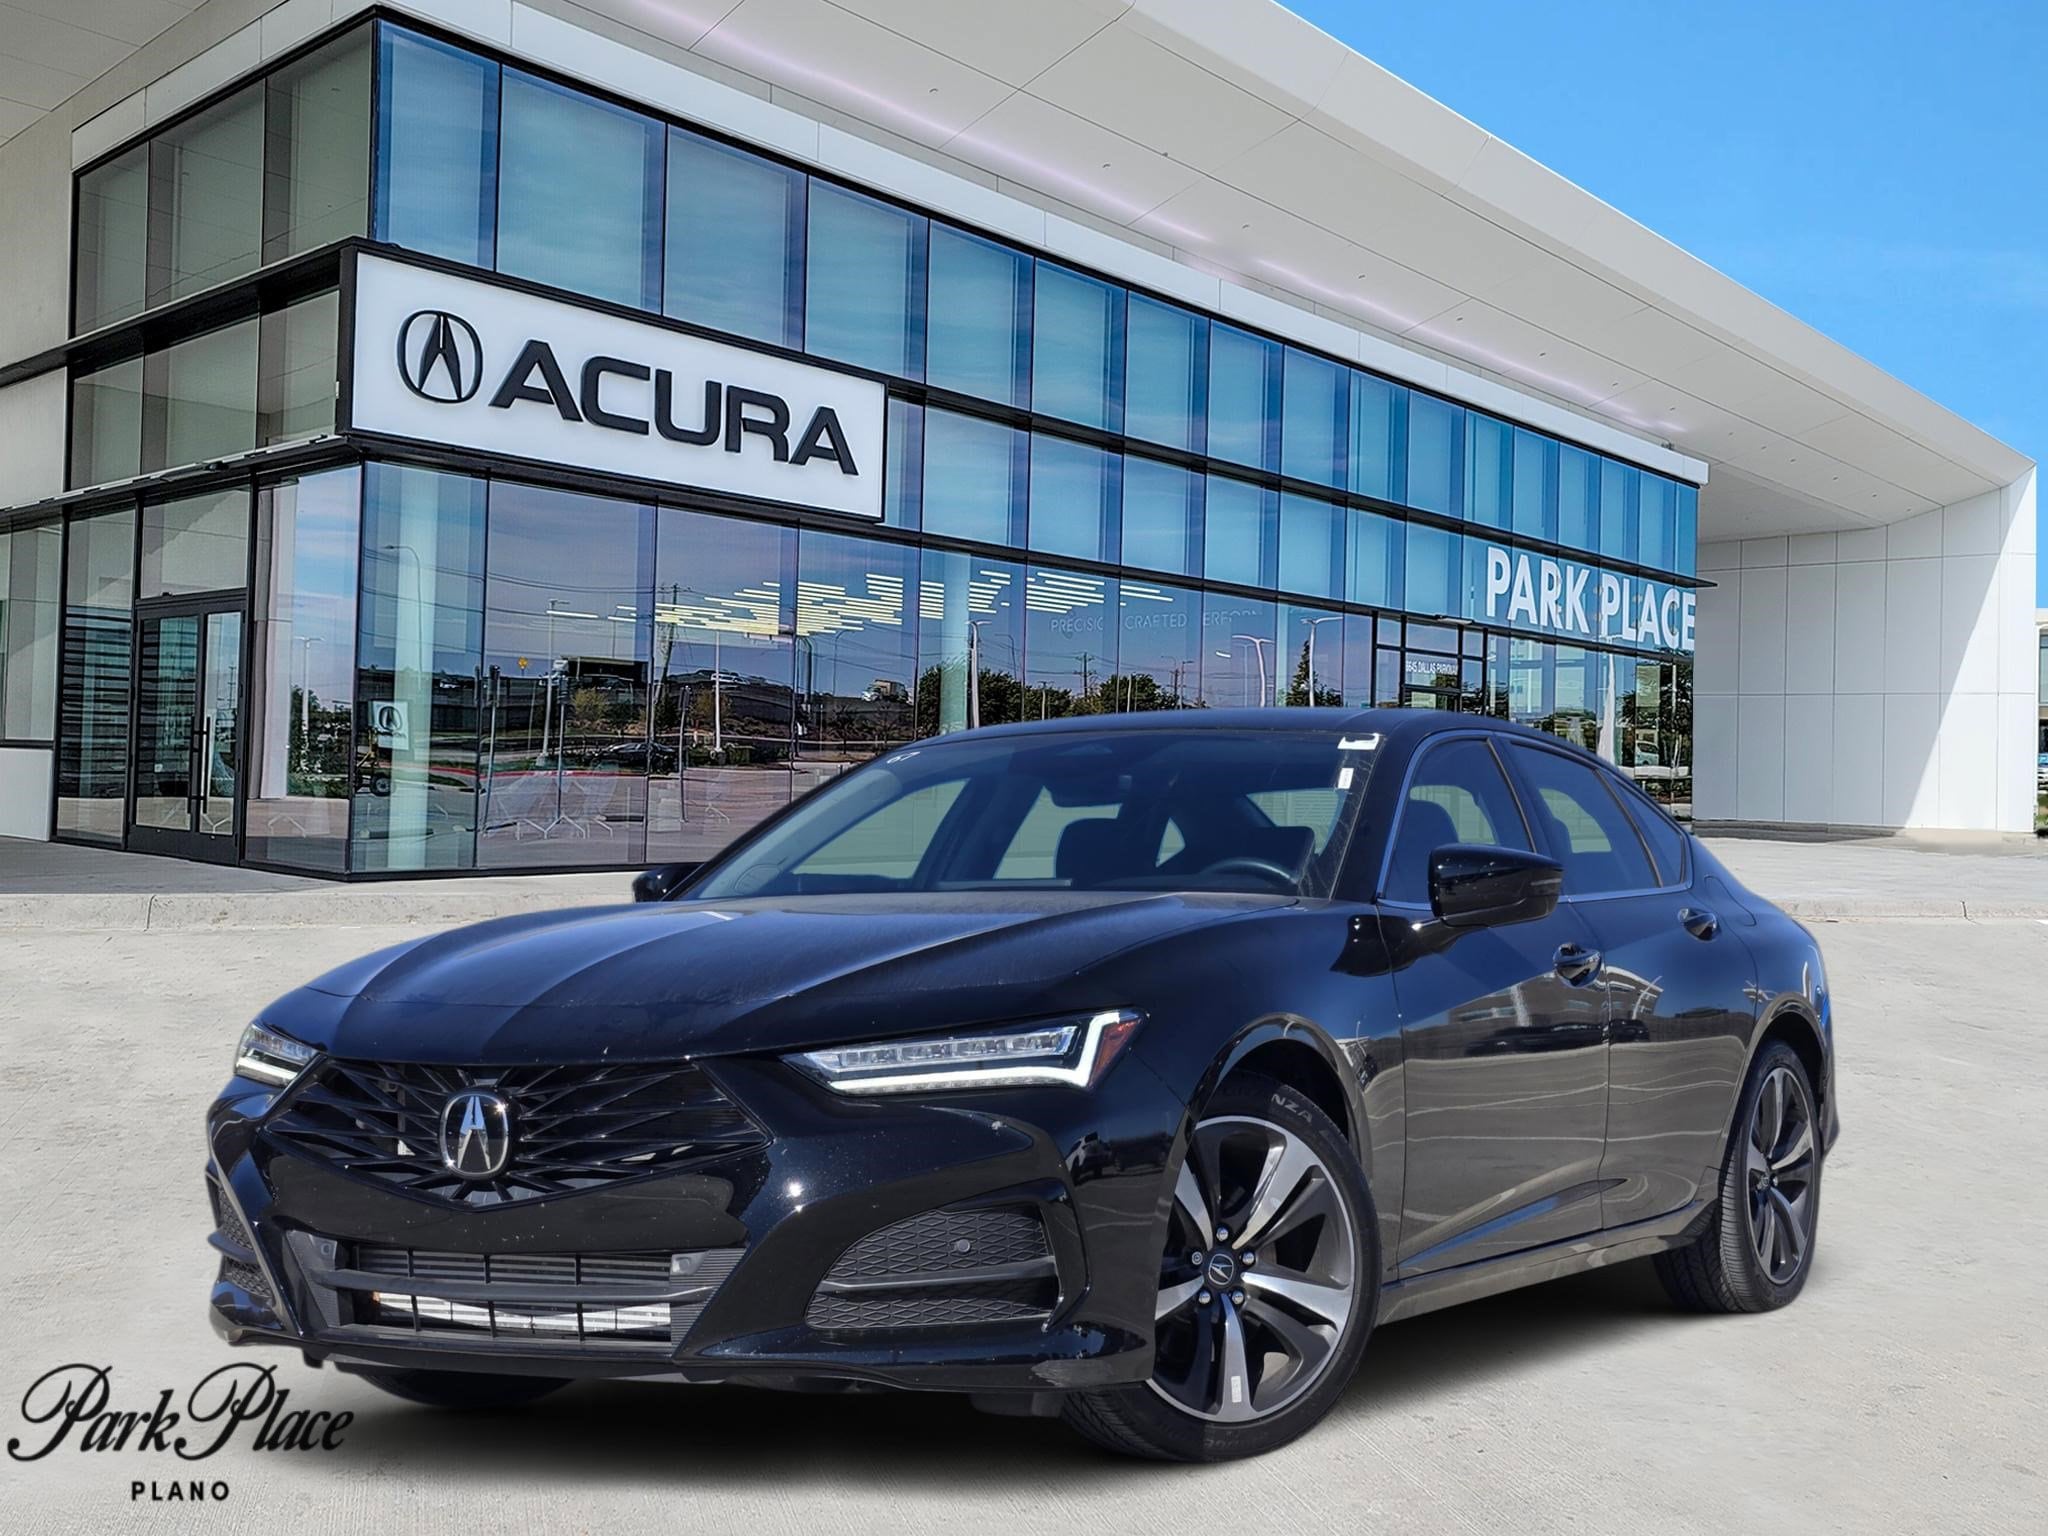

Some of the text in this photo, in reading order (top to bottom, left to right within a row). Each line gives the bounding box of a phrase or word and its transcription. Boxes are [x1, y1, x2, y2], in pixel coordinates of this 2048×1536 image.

[489, 339, 859, 476] ACURA
[1124, 613, 1188, 630] CRAFTED
[1486, 546, 1696, 651] PARK PLACE
